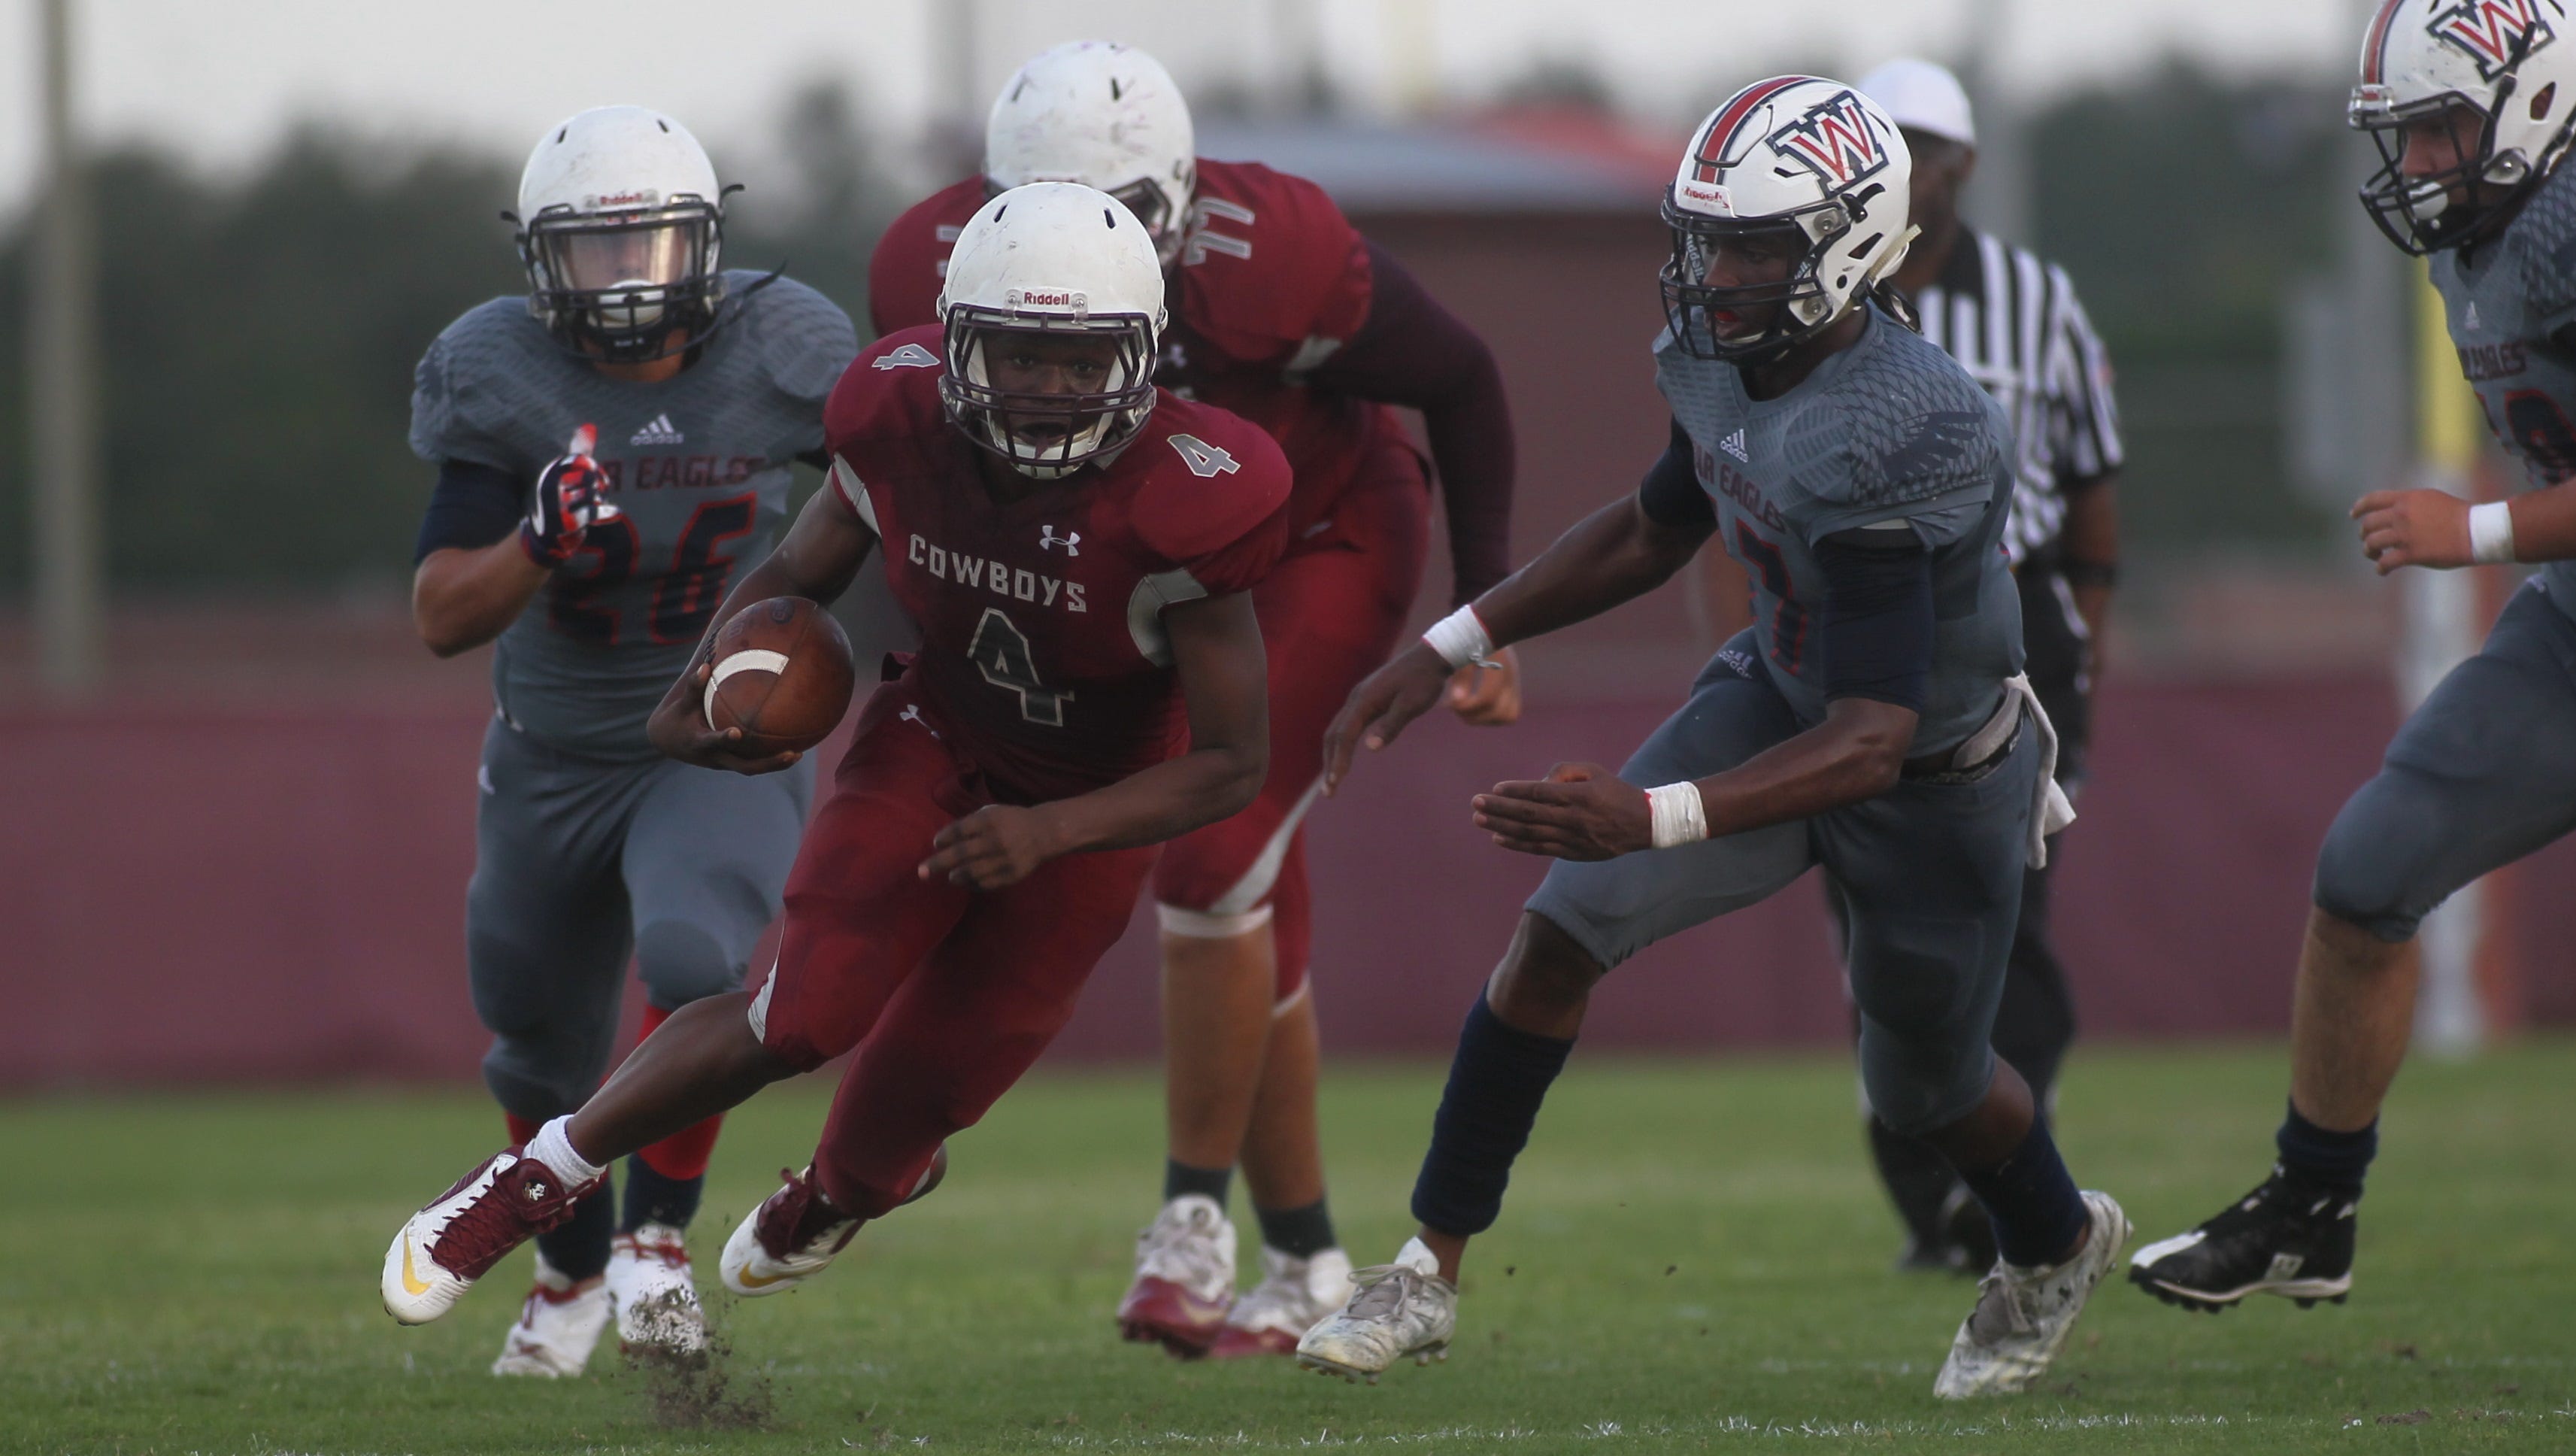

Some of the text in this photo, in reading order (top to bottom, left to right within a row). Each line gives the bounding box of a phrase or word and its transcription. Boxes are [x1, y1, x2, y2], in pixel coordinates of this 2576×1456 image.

[2426, 0, 2556, 83] W
[1765, 90, 1890, 200] W
[1024, 292, 1069, 305] Riddell
[871, 343, 941, 371] 4
[1167, 434, 1242, 478] 4
[1720, 440, 1749, 463] adidas
[547, 491, 758, 646] 26
[909, 533, 1087, 613] COWBOYS
[967, 607, 1075, 727] 4
